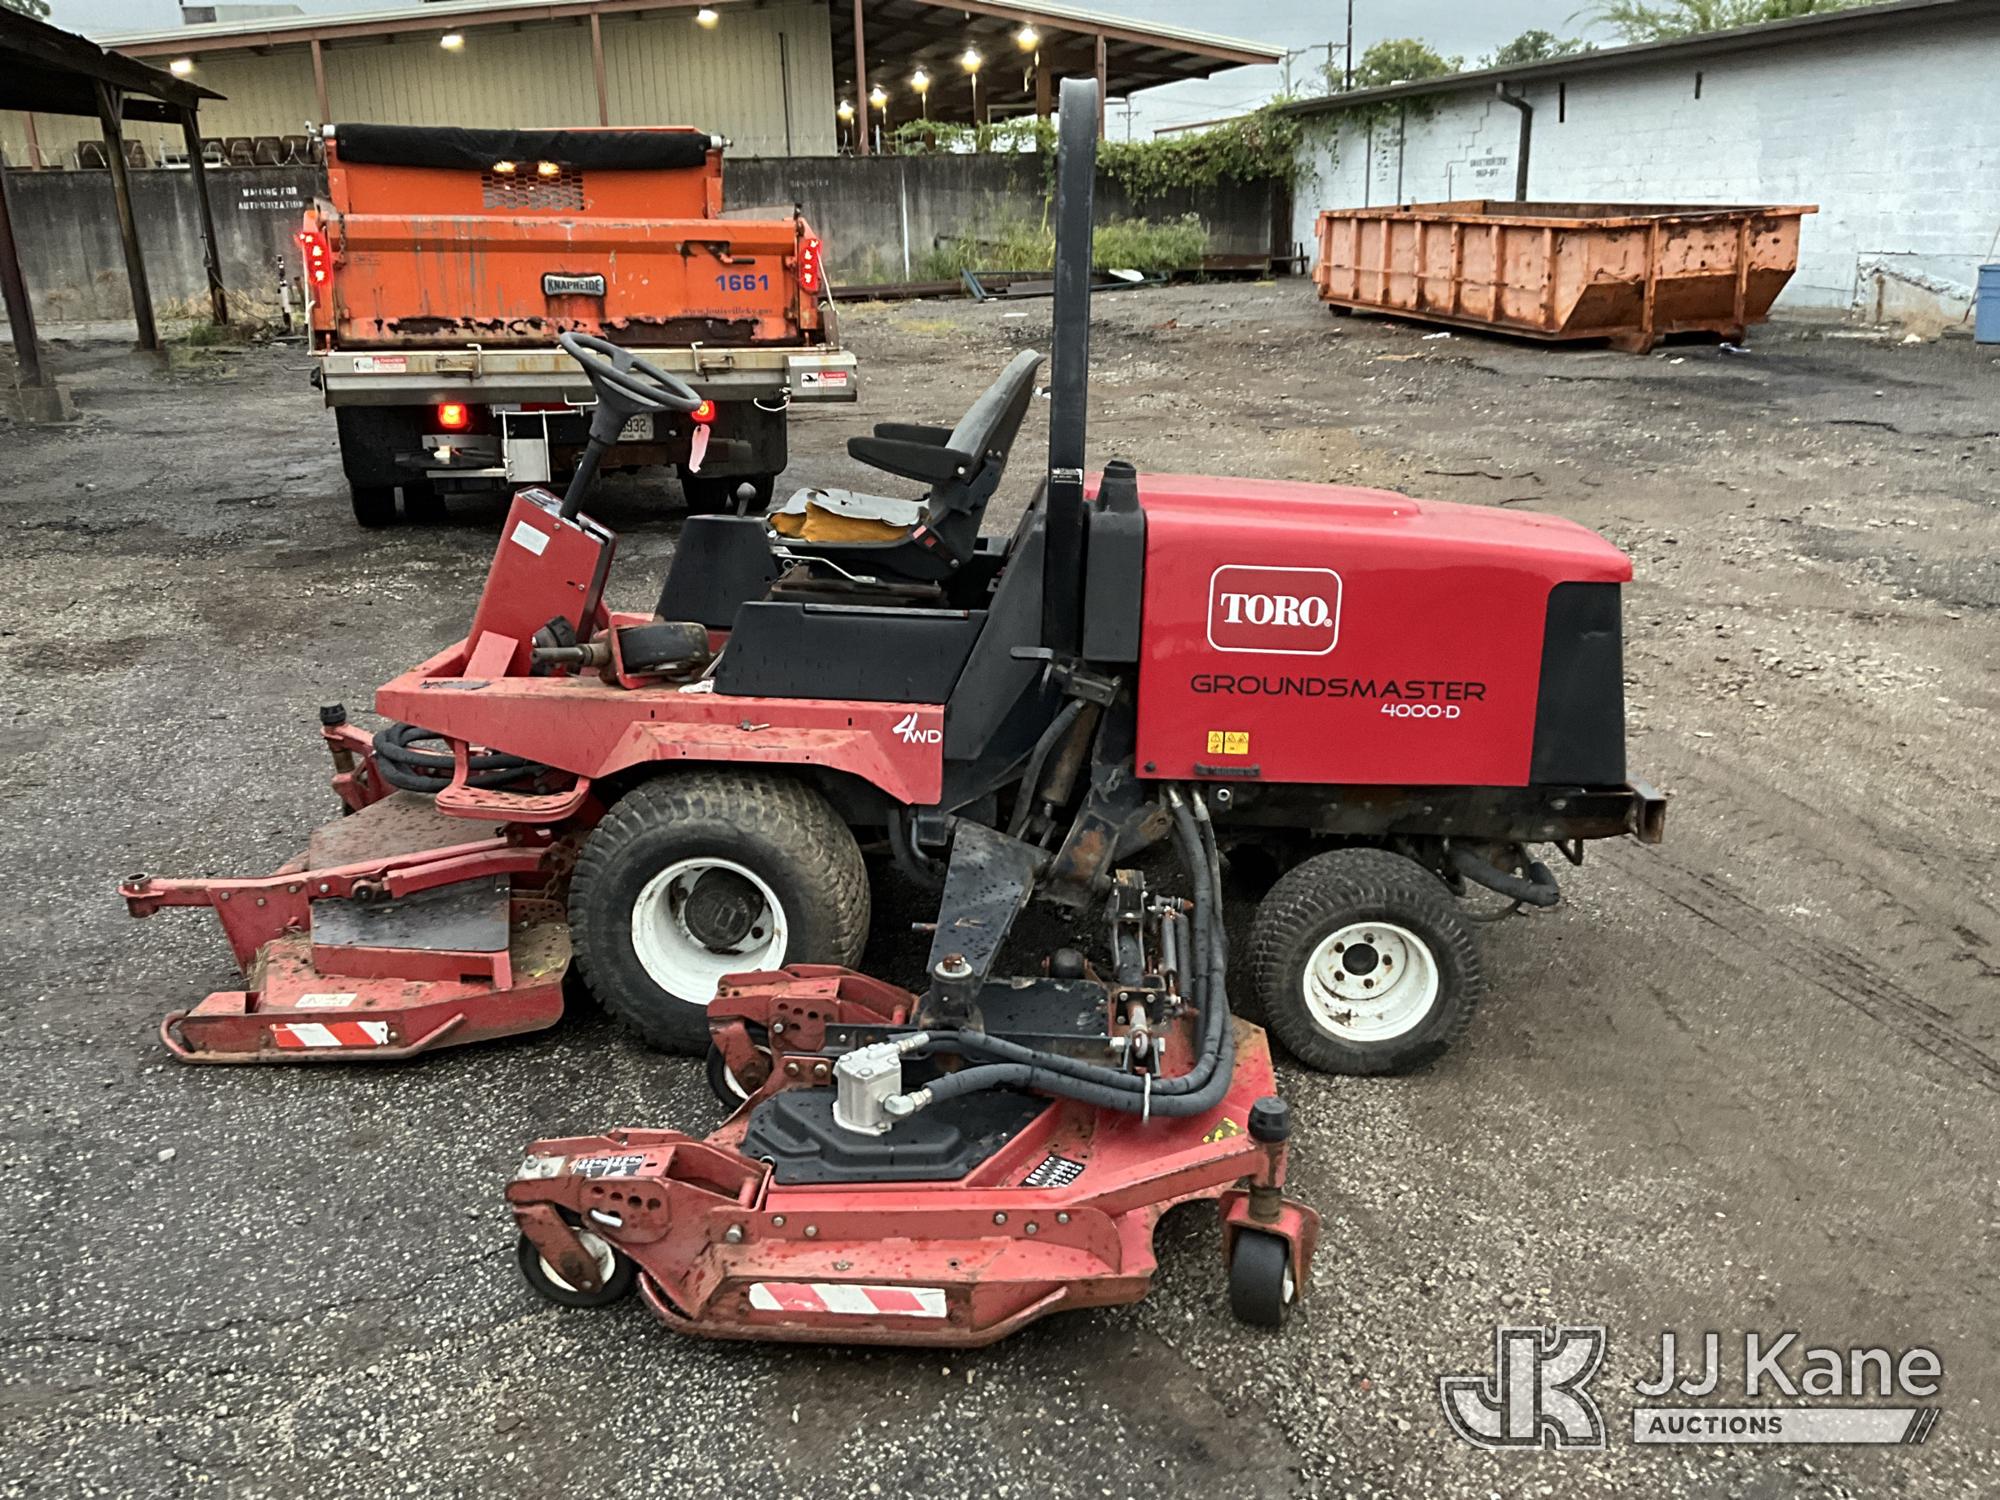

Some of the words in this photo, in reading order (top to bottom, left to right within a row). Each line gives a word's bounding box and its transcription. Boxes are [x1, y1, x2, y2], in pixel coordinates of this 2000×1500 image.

[546, 278, 602, 293] KNAPHEIDE
[715, 274, 769, 291] 1661
[1190, 674, 1487, 701] GROUNDSMASTER
[892, 711, 943, 743] 4WD
